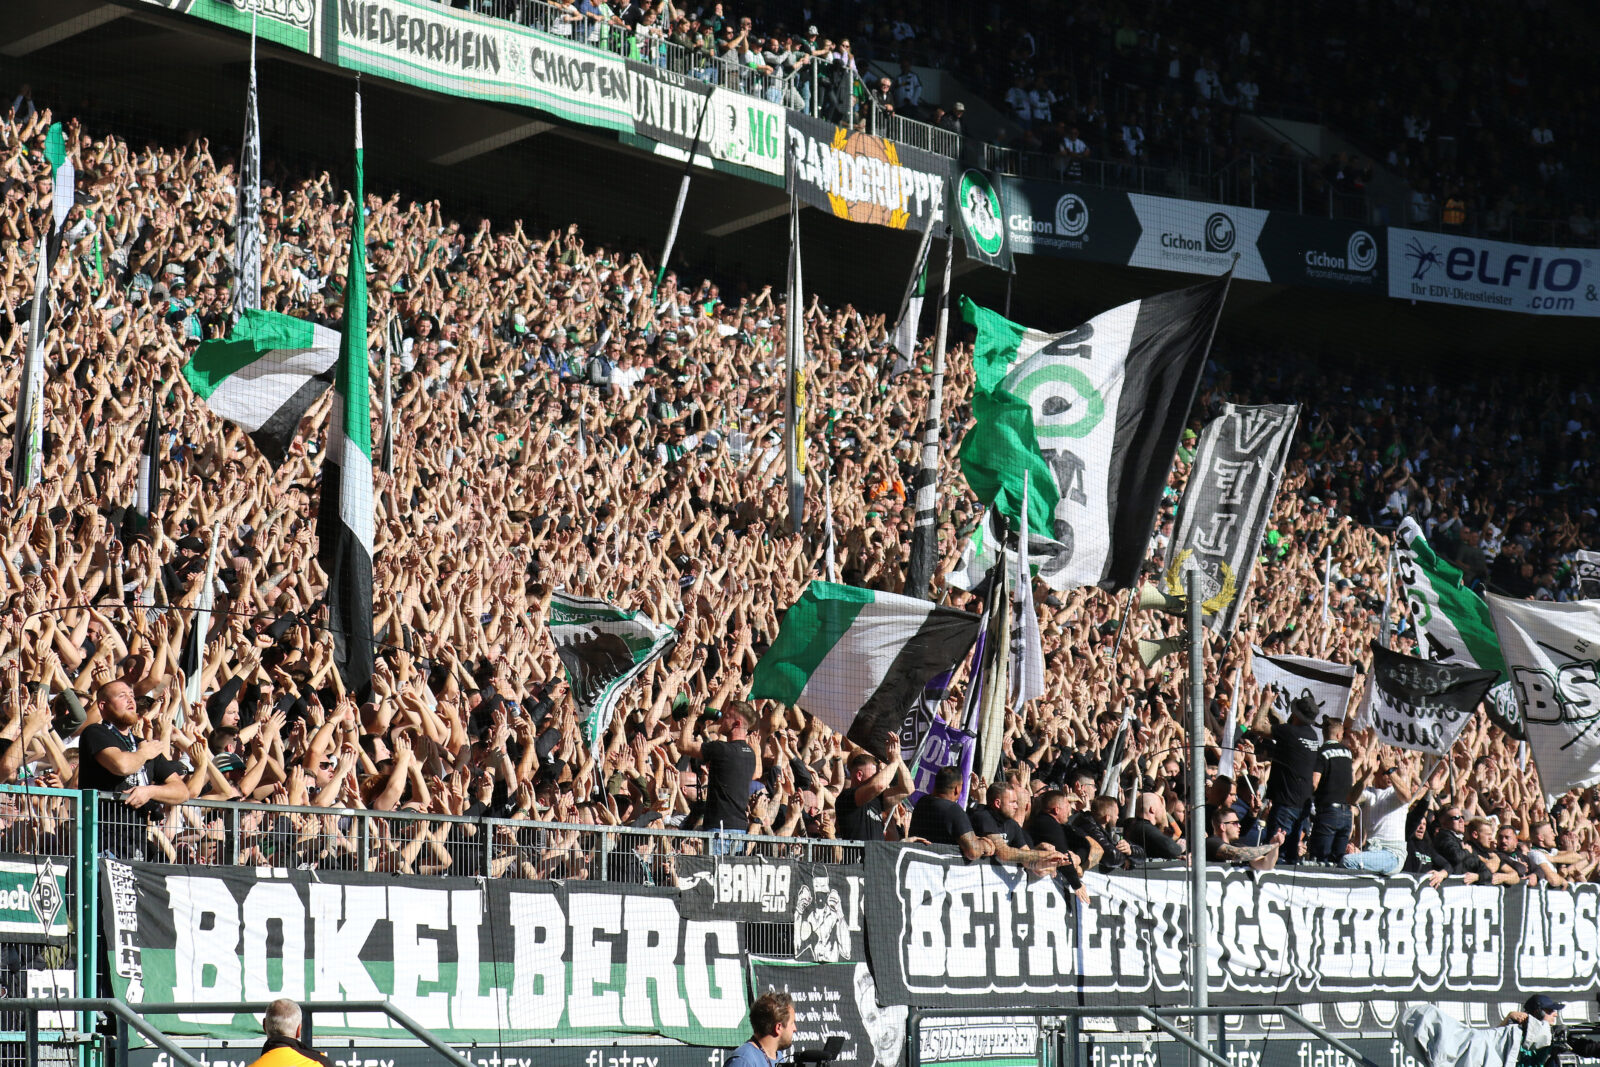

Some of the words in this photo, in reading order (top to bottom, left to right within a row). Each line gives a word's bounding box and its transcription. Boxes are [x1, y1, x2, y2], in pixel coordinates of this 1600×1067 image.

[530, 45, 629, 102] CHAOTEN
[628, 69, 715, 143] UNITED
[747, 106, 778, 160] MG
[1009, 214, 1053, 234] Cichon
[1009, 232, 1083, 250] Personalmanagement
[1160, 231, 1203, 252] Cichon
[1305, 249, 1346, 271] Cichon
[1411, 282, 1427, 297] Ihr
[1429, 283, 1513, 307] EDV-Dienstleister
[1525, 293, 1575, 311] .com
[718, 864, 792, 903] BANDA
[762, 895, 787, 913] SUD
[904, 858, 1503, 978] BETRETUNGSVERBOTE
[164, 866, 748, 1030] BÖKELBERG
